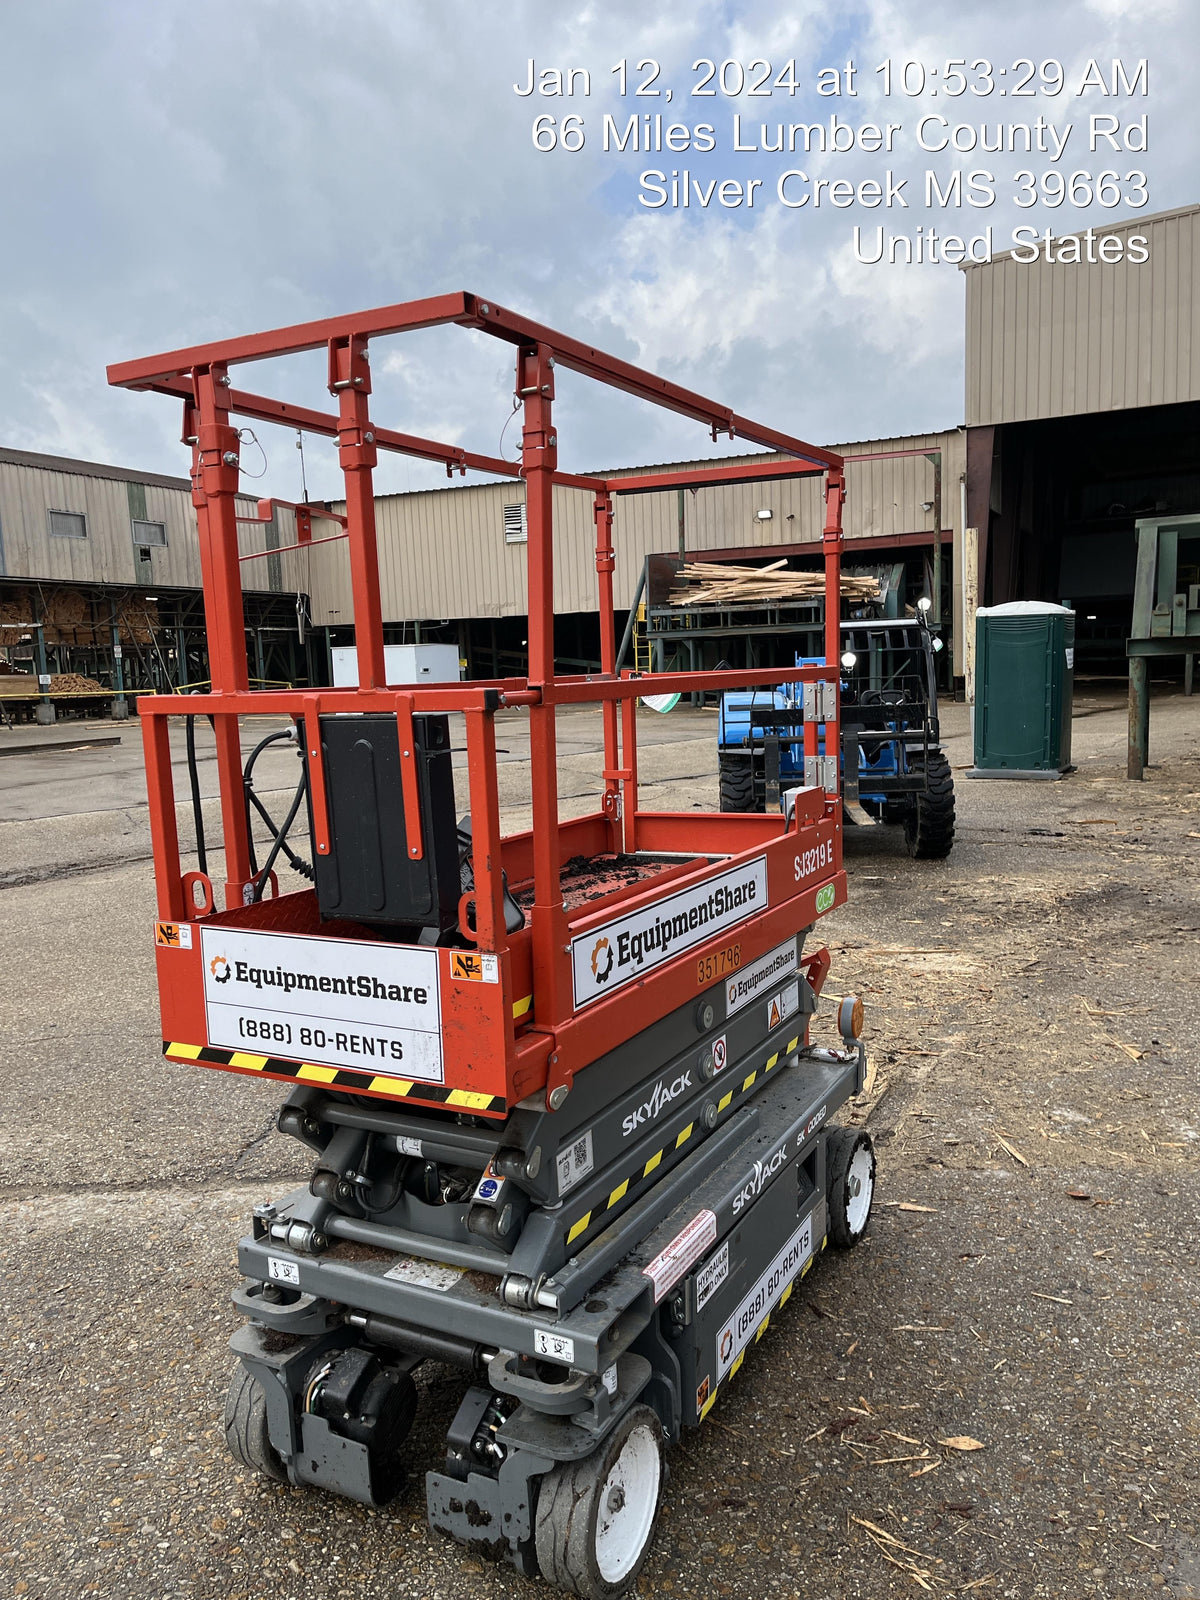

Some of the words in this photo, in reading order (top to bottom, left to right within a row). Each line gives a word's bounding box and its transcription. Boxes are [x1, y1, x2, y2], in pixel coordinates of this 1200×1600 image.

[794, 843, 826, 881] SJ3219
[827, 839, 833, 863] E
[617, 878, 756, 967] EquipmentShare
[235, 961, 428, 1005] EquipmentShare
[698, 944, 741, 983] 351796
[738, 949, 795, 997] EquipmentShare
[239, 1016, 292, 1044] (888)
[300, 1029, 404, 1060] 80-RENTS
[622, 1069, 693, 1137] SKYJACK
[732, 1145, 788, 1215] SKYJACK
[738, 1288, 765, 1340] (888)
[767, 1230, 810, 1296] 80-RENTS
